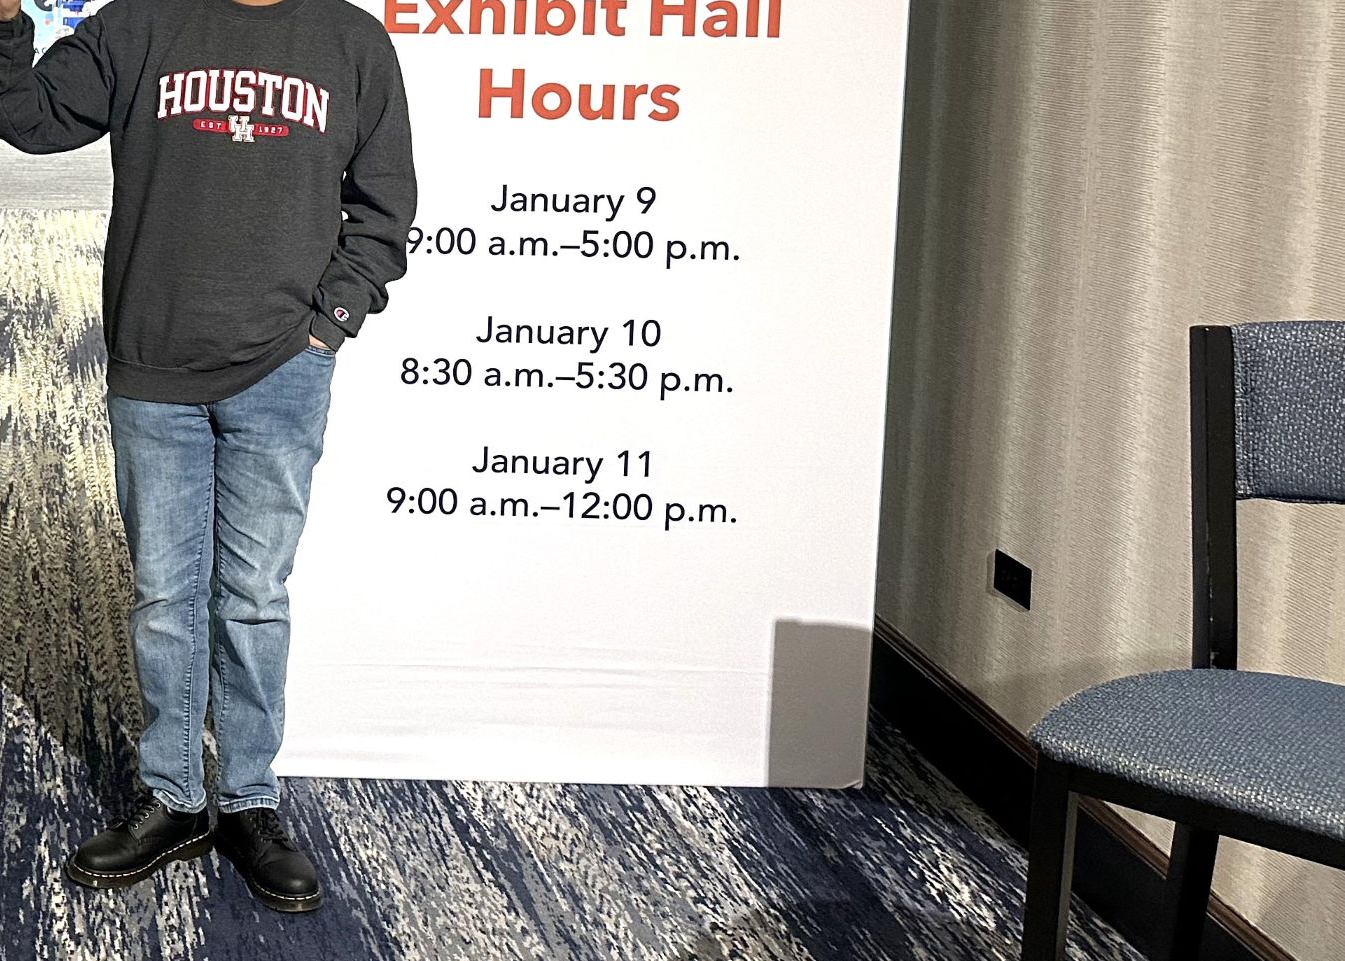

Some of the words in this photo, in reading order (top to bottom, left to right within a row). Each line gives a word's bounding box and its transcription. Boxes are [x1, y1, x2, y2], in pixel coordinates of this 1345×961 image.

[157, 69, 330, 132] HOUSTON
[479, 68, 680, 121] Hours
[491, 185, 624, 222] January
[637, 187, 656, 214] 9
[406, 227, 478, 256] 9:00
[667, 241, 739, 269] p.m.
[476, 316, 608, 353] January
[623, 320, 660, 347] 10
[401, 358, 471, 385] 8:30
[660, 373, 732, 400] p.m.
[472, 446, 603, 484] January
[618, 450, 649, 477] 11
[387, 487, 457, 515] 9:00
[665, 503, 736, 531] p.m.
